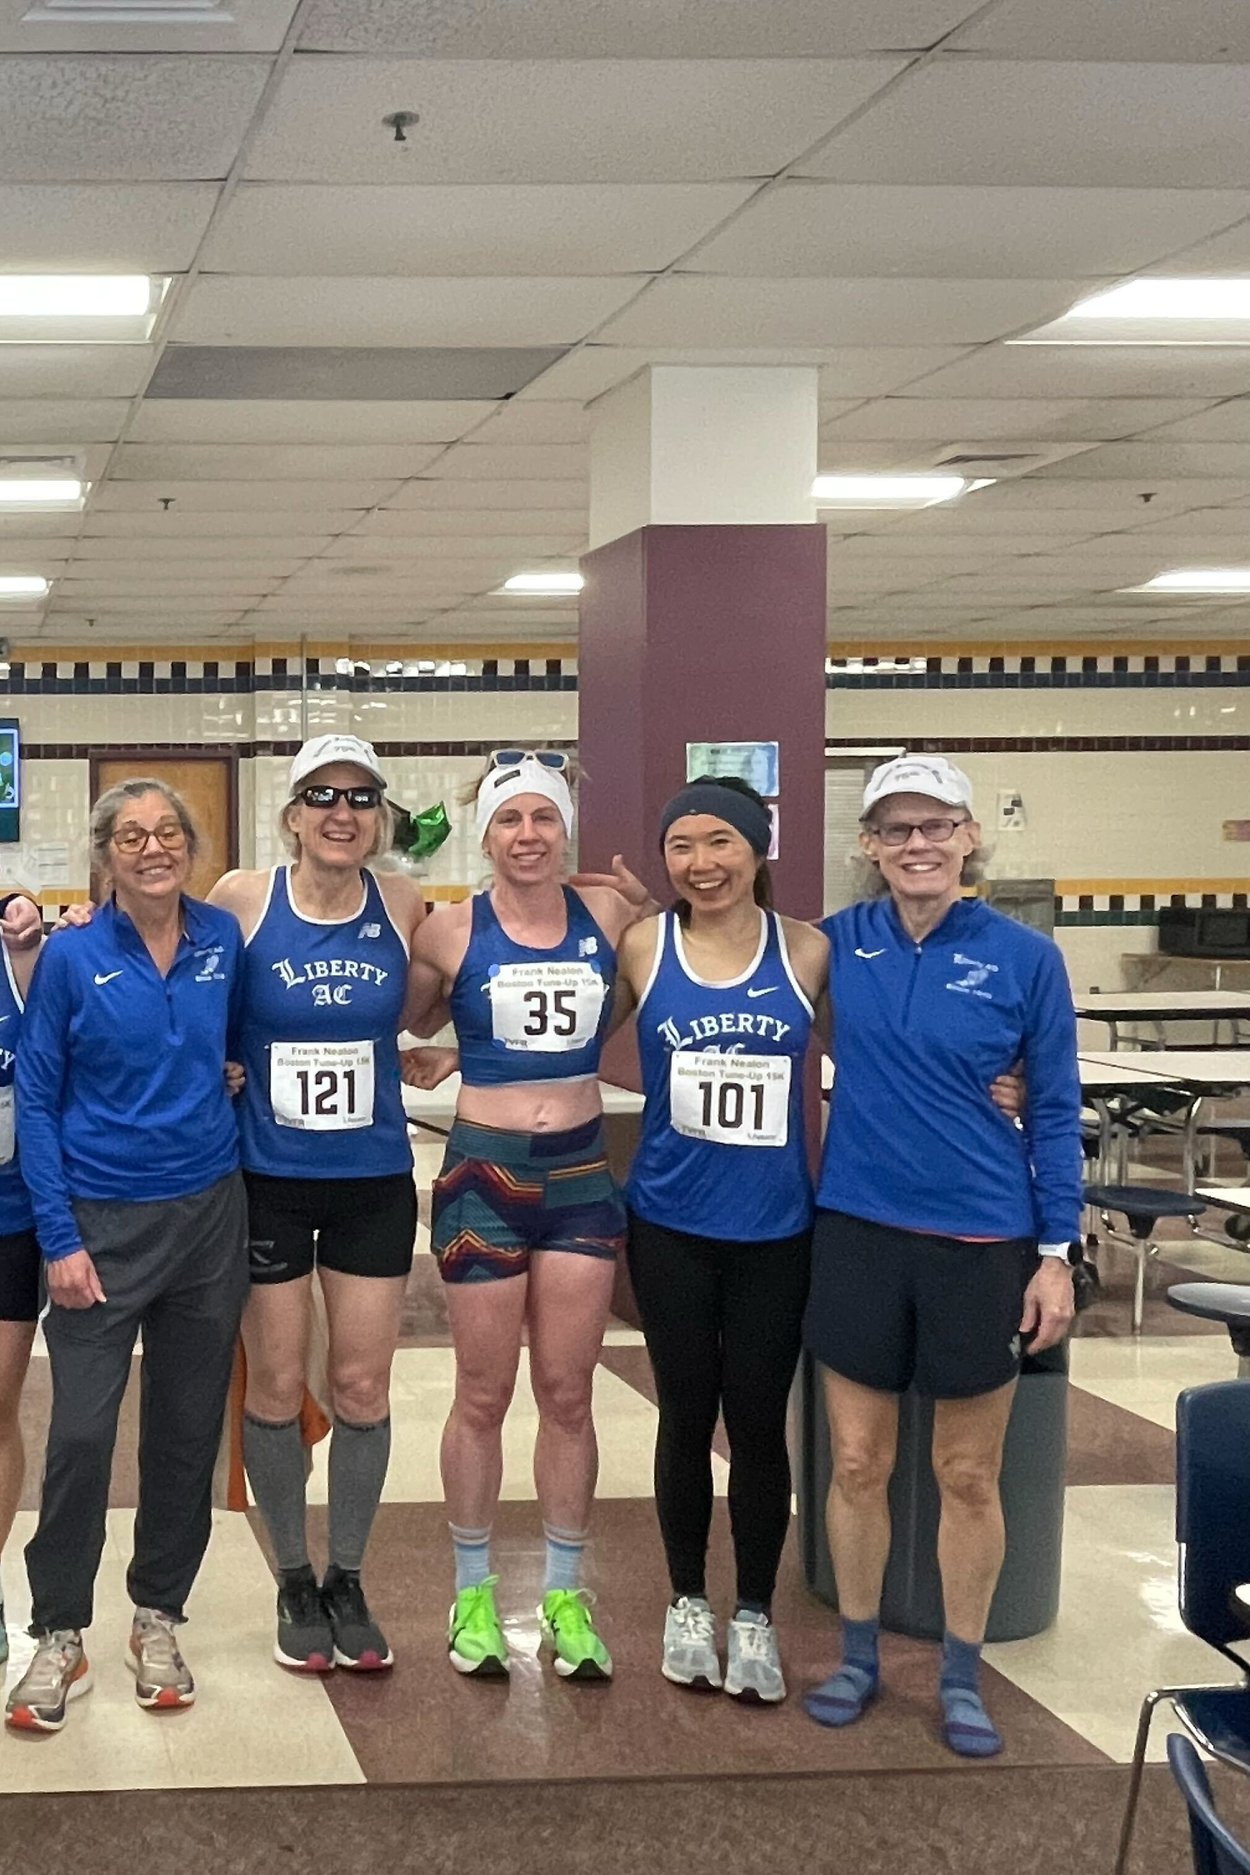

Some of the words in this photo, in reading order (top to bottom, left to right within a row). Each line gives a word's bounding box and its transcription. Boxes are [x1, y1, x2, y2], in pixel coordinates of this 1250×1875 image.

[311, 982, 352, 1007] AC
[524, 990, 576, 1036] 35
[297, 1070, 355, 1115] 121
[698, 1081, 764, 1131] 101
